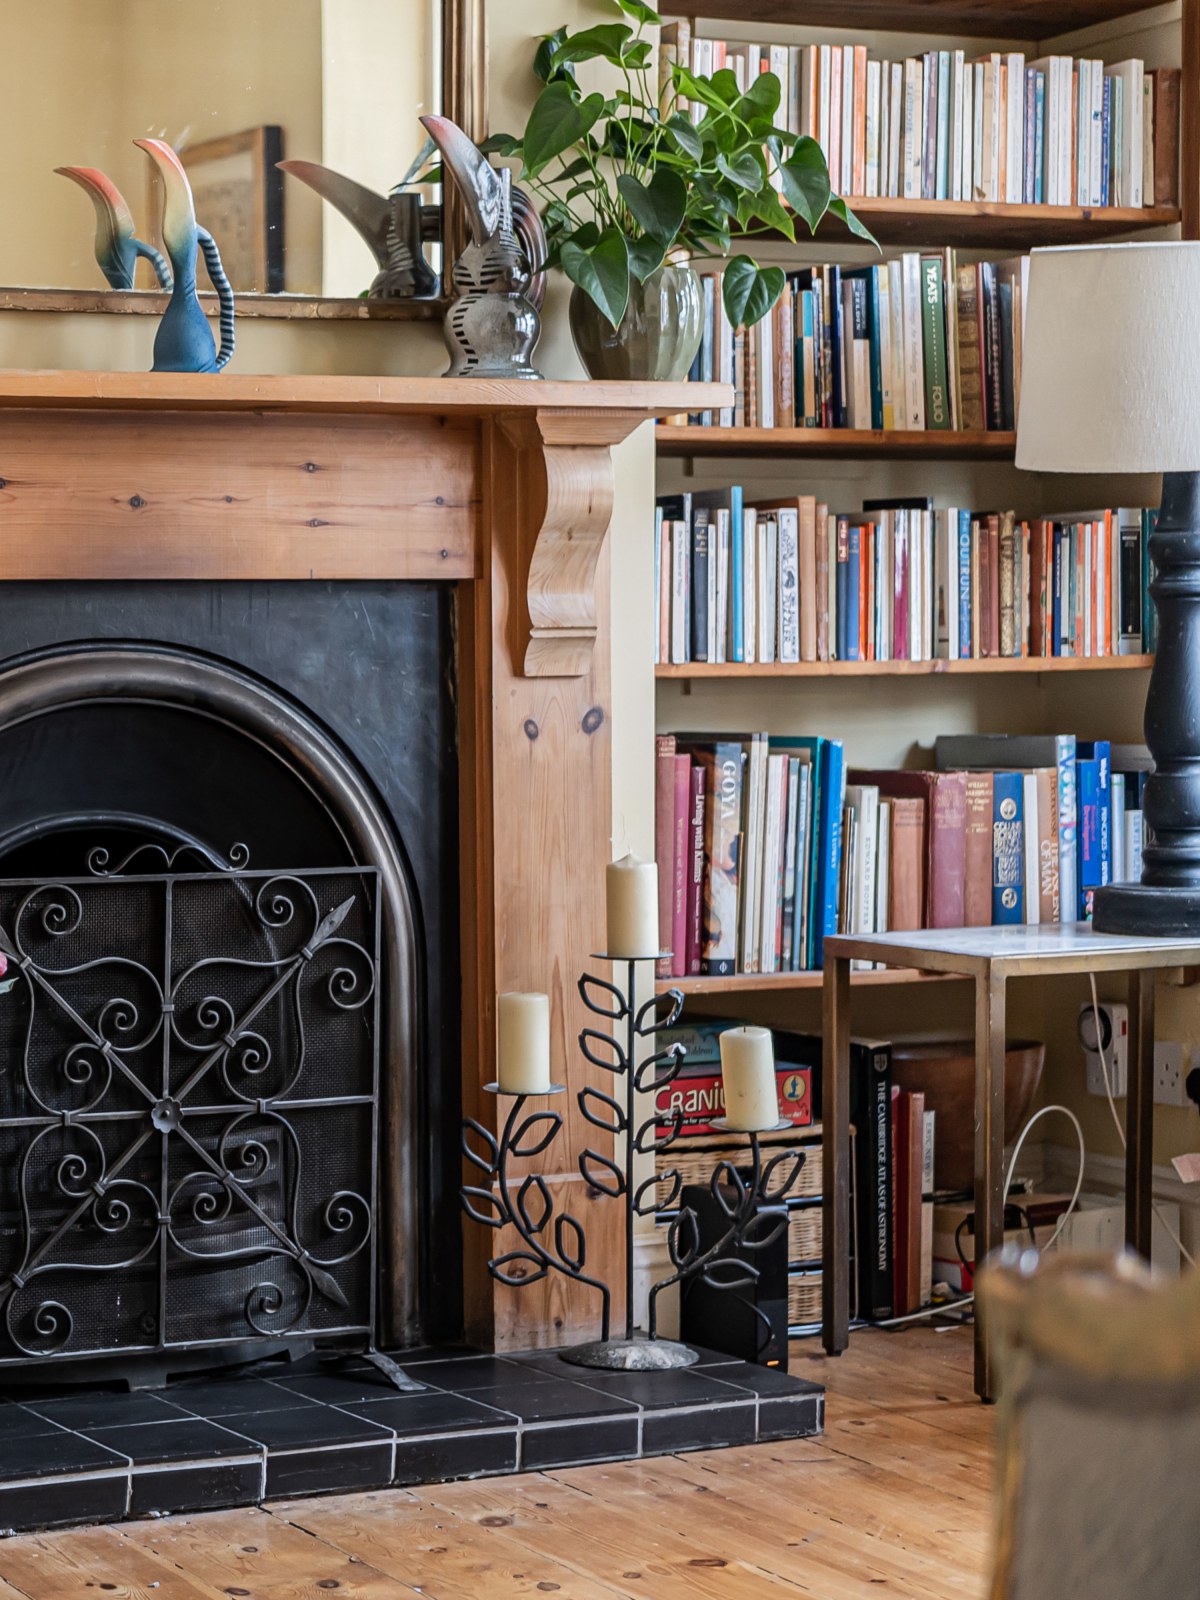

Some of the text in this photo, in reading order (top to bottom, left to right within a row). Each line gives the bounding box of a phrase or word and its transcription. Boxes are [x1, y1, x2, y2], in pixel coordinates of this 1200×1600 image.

[926, 265, 943, 423] YEATS FOLIO
[960, 533, 969, 600] OUTRUN
[693, 794, 704, 826] Living
[721, 760, 736, 820] GOYA
[695, 826, 704, 849] with
[694, 849, 704, 884] Kilims
[1041, 839, 1051, 896] OF MAN
[877, 1081, 886, 1272] THE CAMBRIDGE ATLAS OF ASTRONOMY
[924, 1146, 932, 1185] NEWBY
